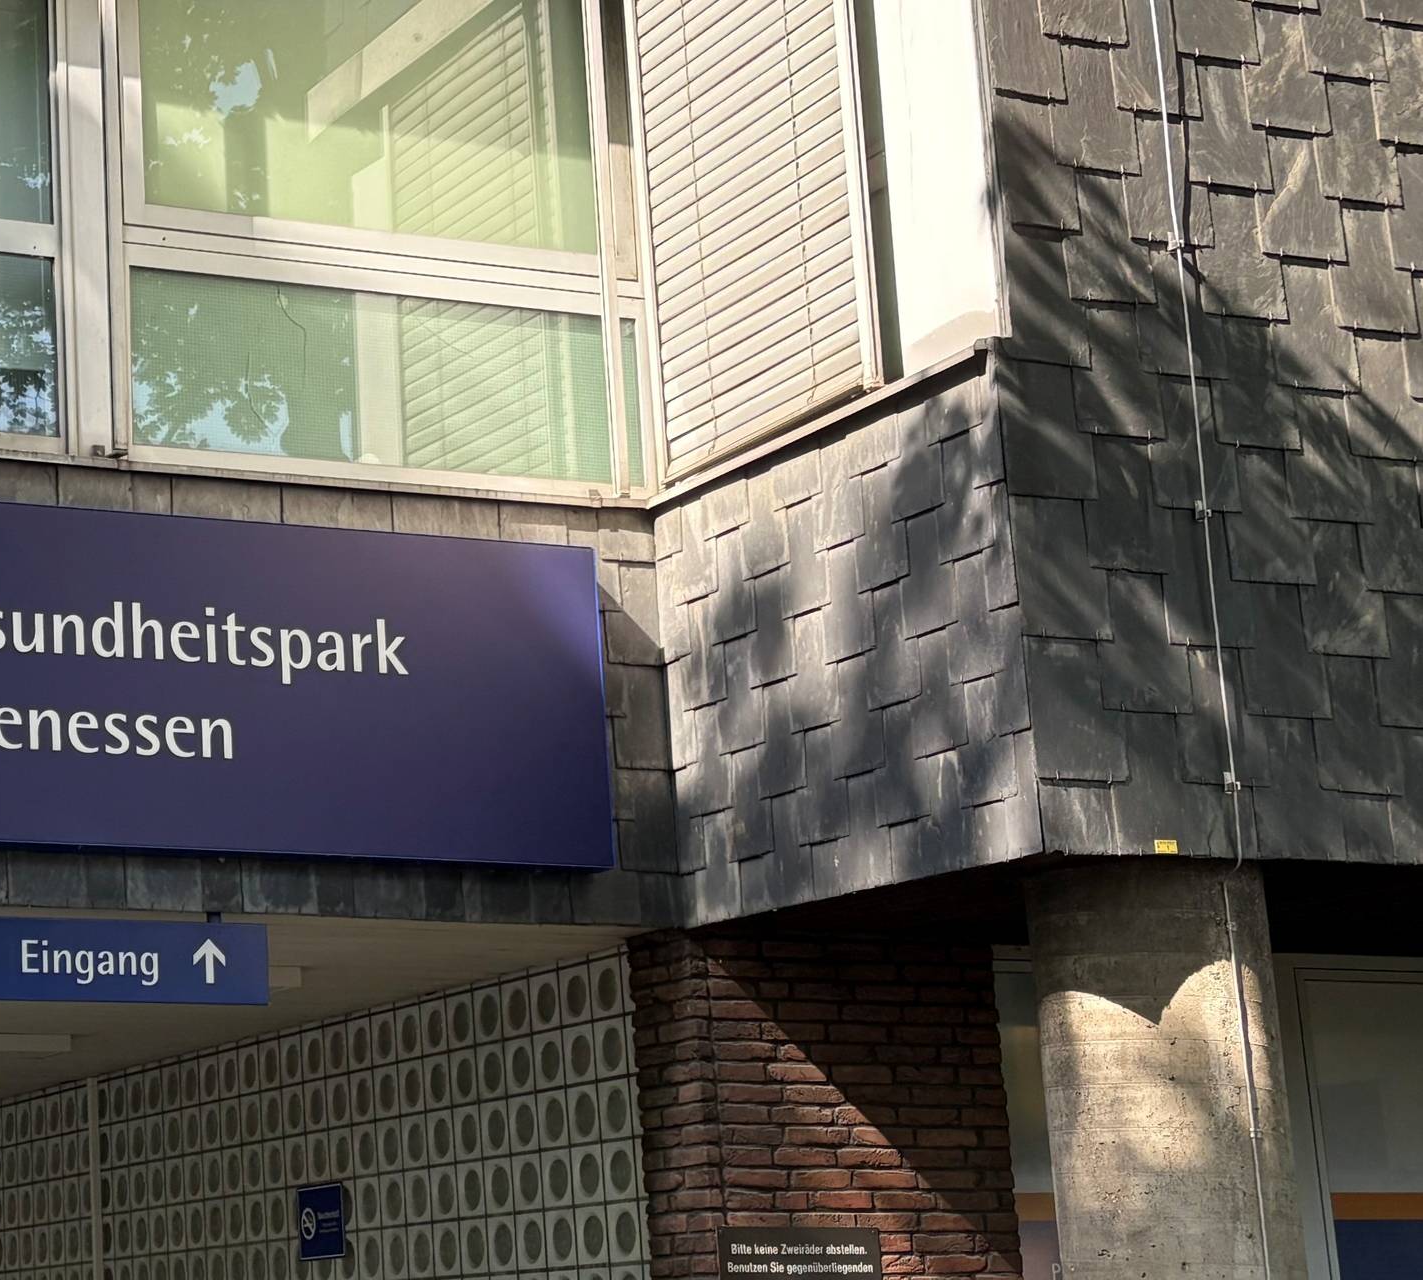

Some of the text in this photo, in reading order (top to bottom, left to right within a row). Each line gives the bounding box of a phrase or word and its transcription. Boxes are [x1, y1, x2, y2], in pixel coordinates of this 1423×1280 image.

[21, 940, 159, 986] Eingang
[731, 1243, 868, 1255] Bitte keine Zweiräder abstellen.
[727, 1261, 873, 1275] Benutzen Sie gegenüberliegenden
